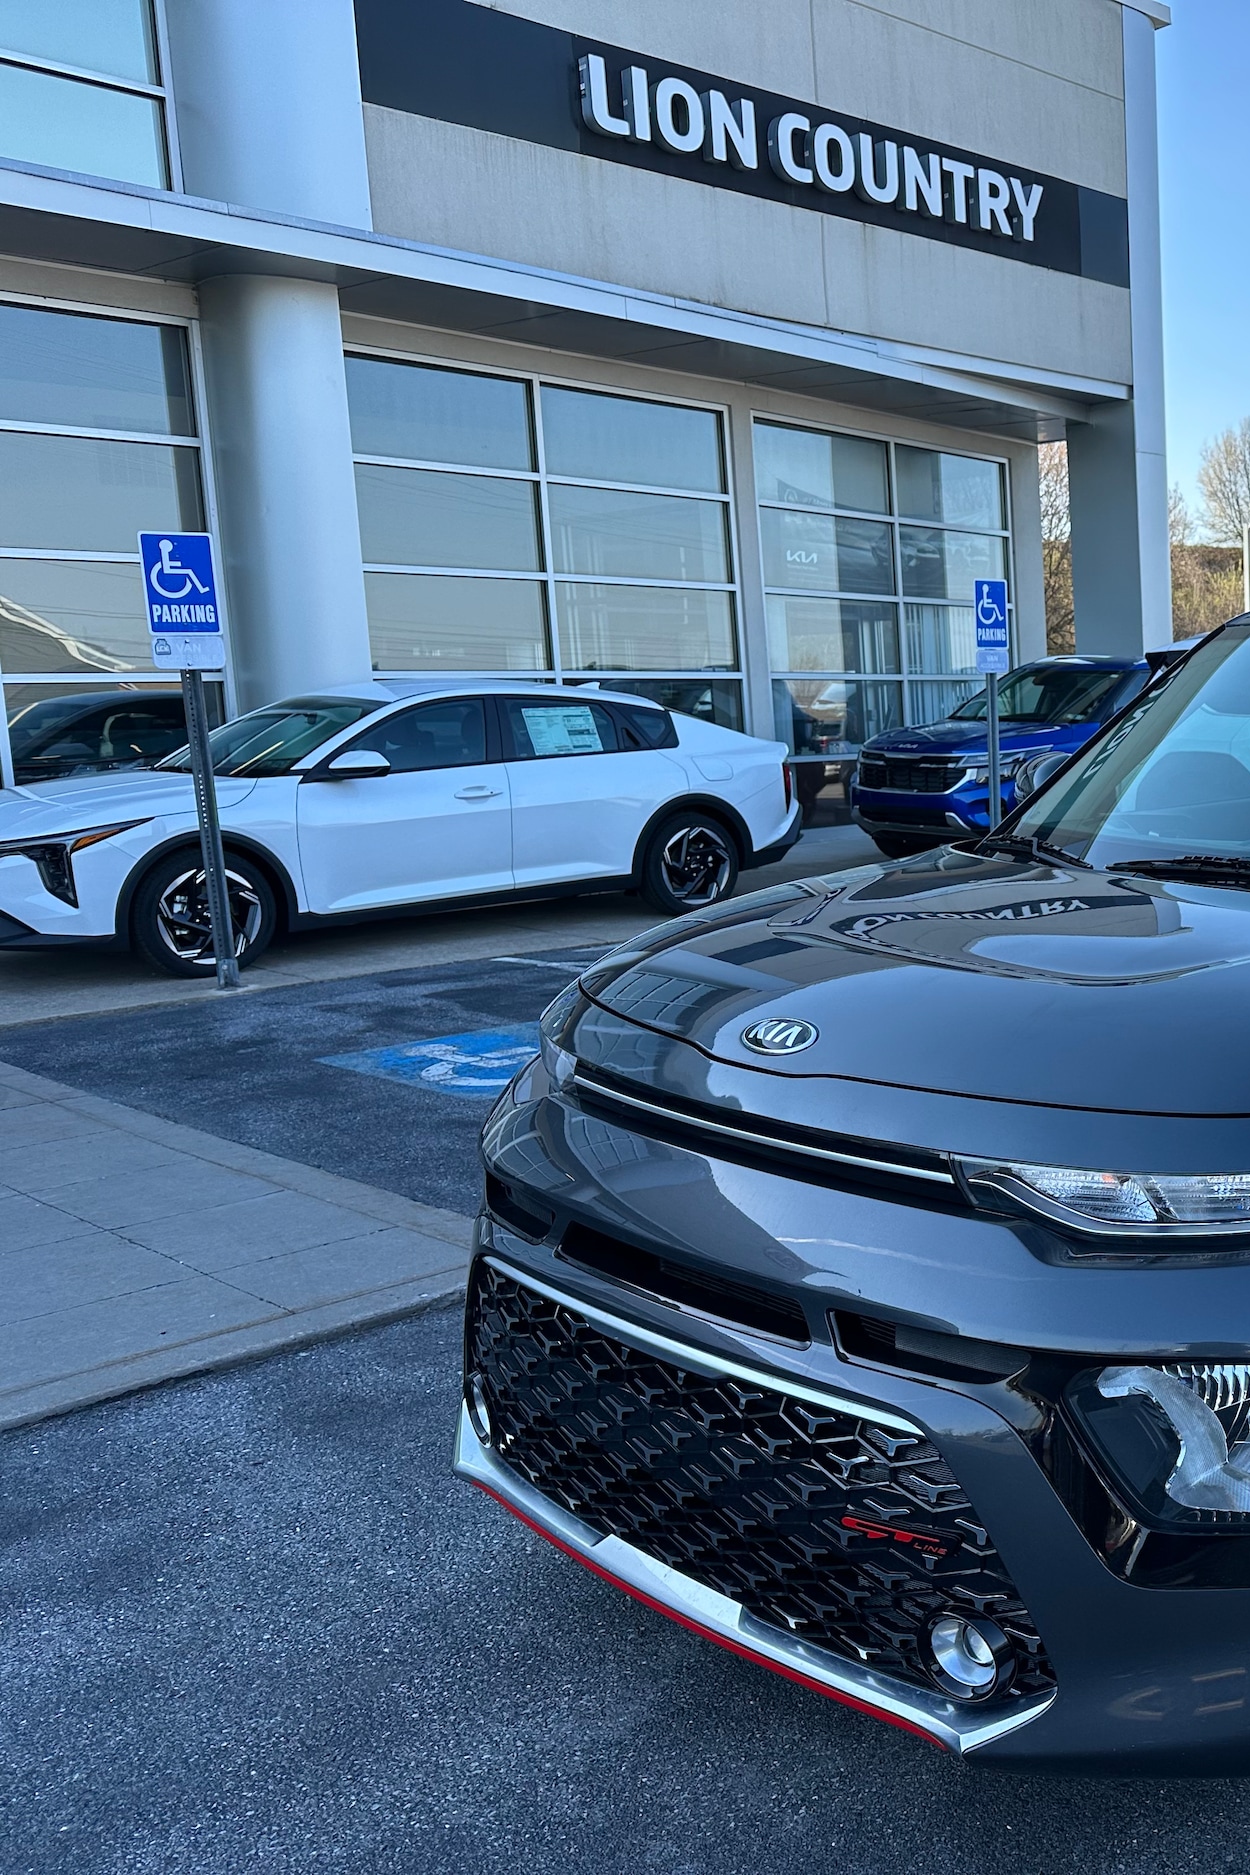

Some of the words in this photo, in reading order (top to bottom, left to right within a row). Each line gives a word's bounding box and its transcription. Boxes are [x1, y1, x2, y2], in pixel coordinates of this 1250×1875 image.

[580, 53, 758, 171] LION
[770, 112, 1043, 242] COUNTRY
[151, 604, 216, 623] PARKING
[977, 628, 1006, 641] PARKING
[175, 643, 202, 653] VAN
[747, 1020, 803, 1048] KIA
[913, 1542, 948, 1555] LINE
